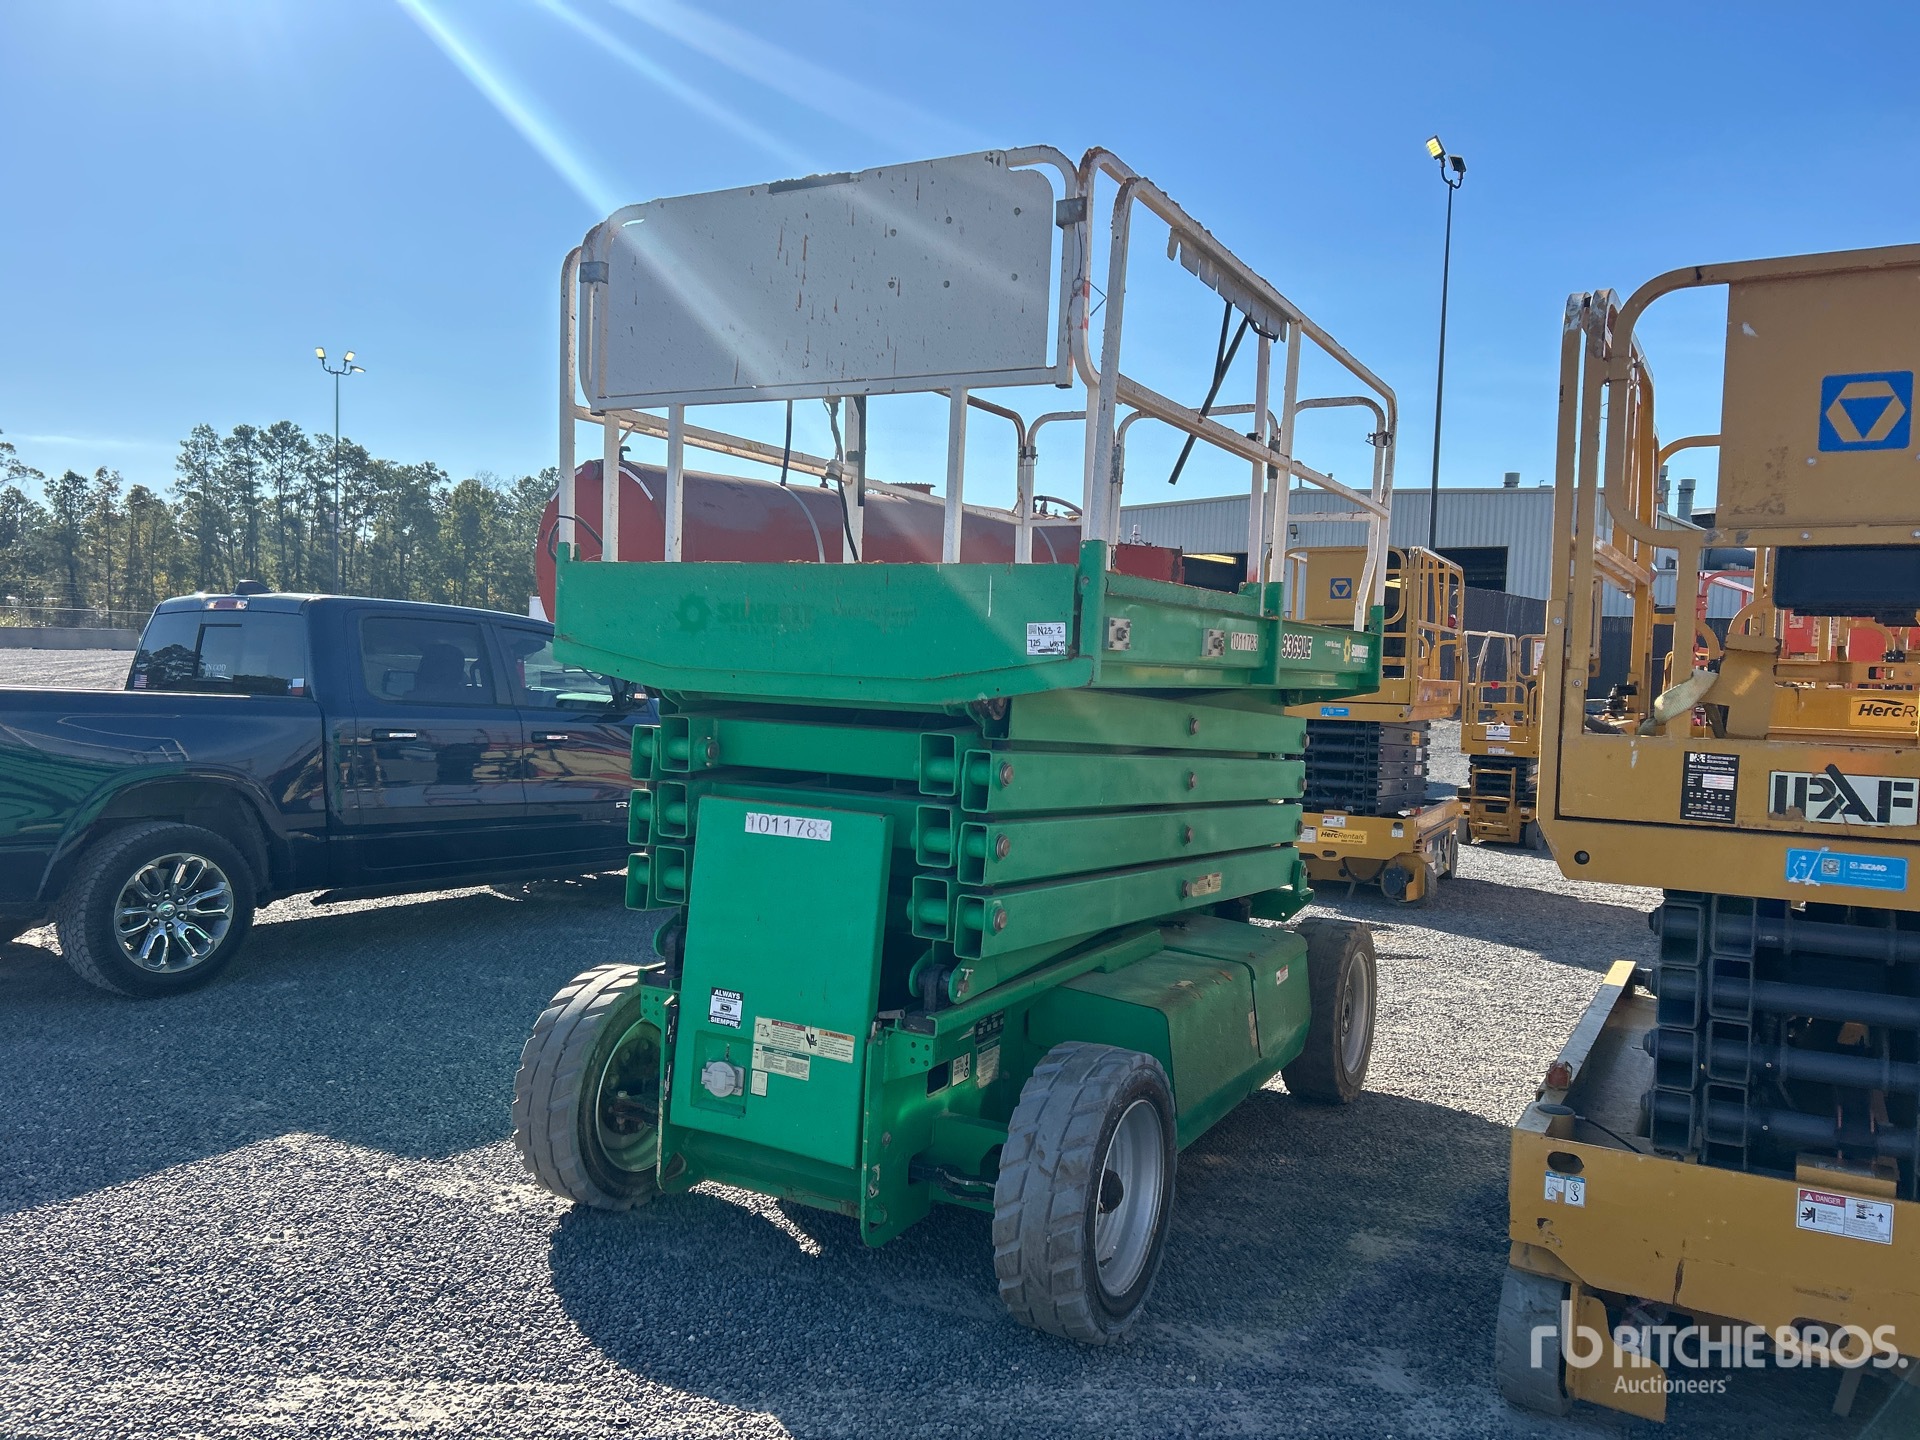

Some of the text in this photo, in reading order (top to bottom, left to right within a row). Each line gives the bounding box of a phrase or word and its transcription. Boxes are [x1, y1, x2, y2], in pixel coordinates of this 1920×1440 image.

[1231, 632, 1258, 651] 1011783
[1281, 633, 1313, 660] 3369LE
[1774, 764, 1914, 823] IPAF
[747, 813, 830, 840] 1011783
[1320, 831, 1365, 841] HercRentals
[714, 989, 740, 1000] ALWAYS
[710, 1016, 739, 1028] SIEMPRE
[1815, 1194, 1841, 1205] DANGER
